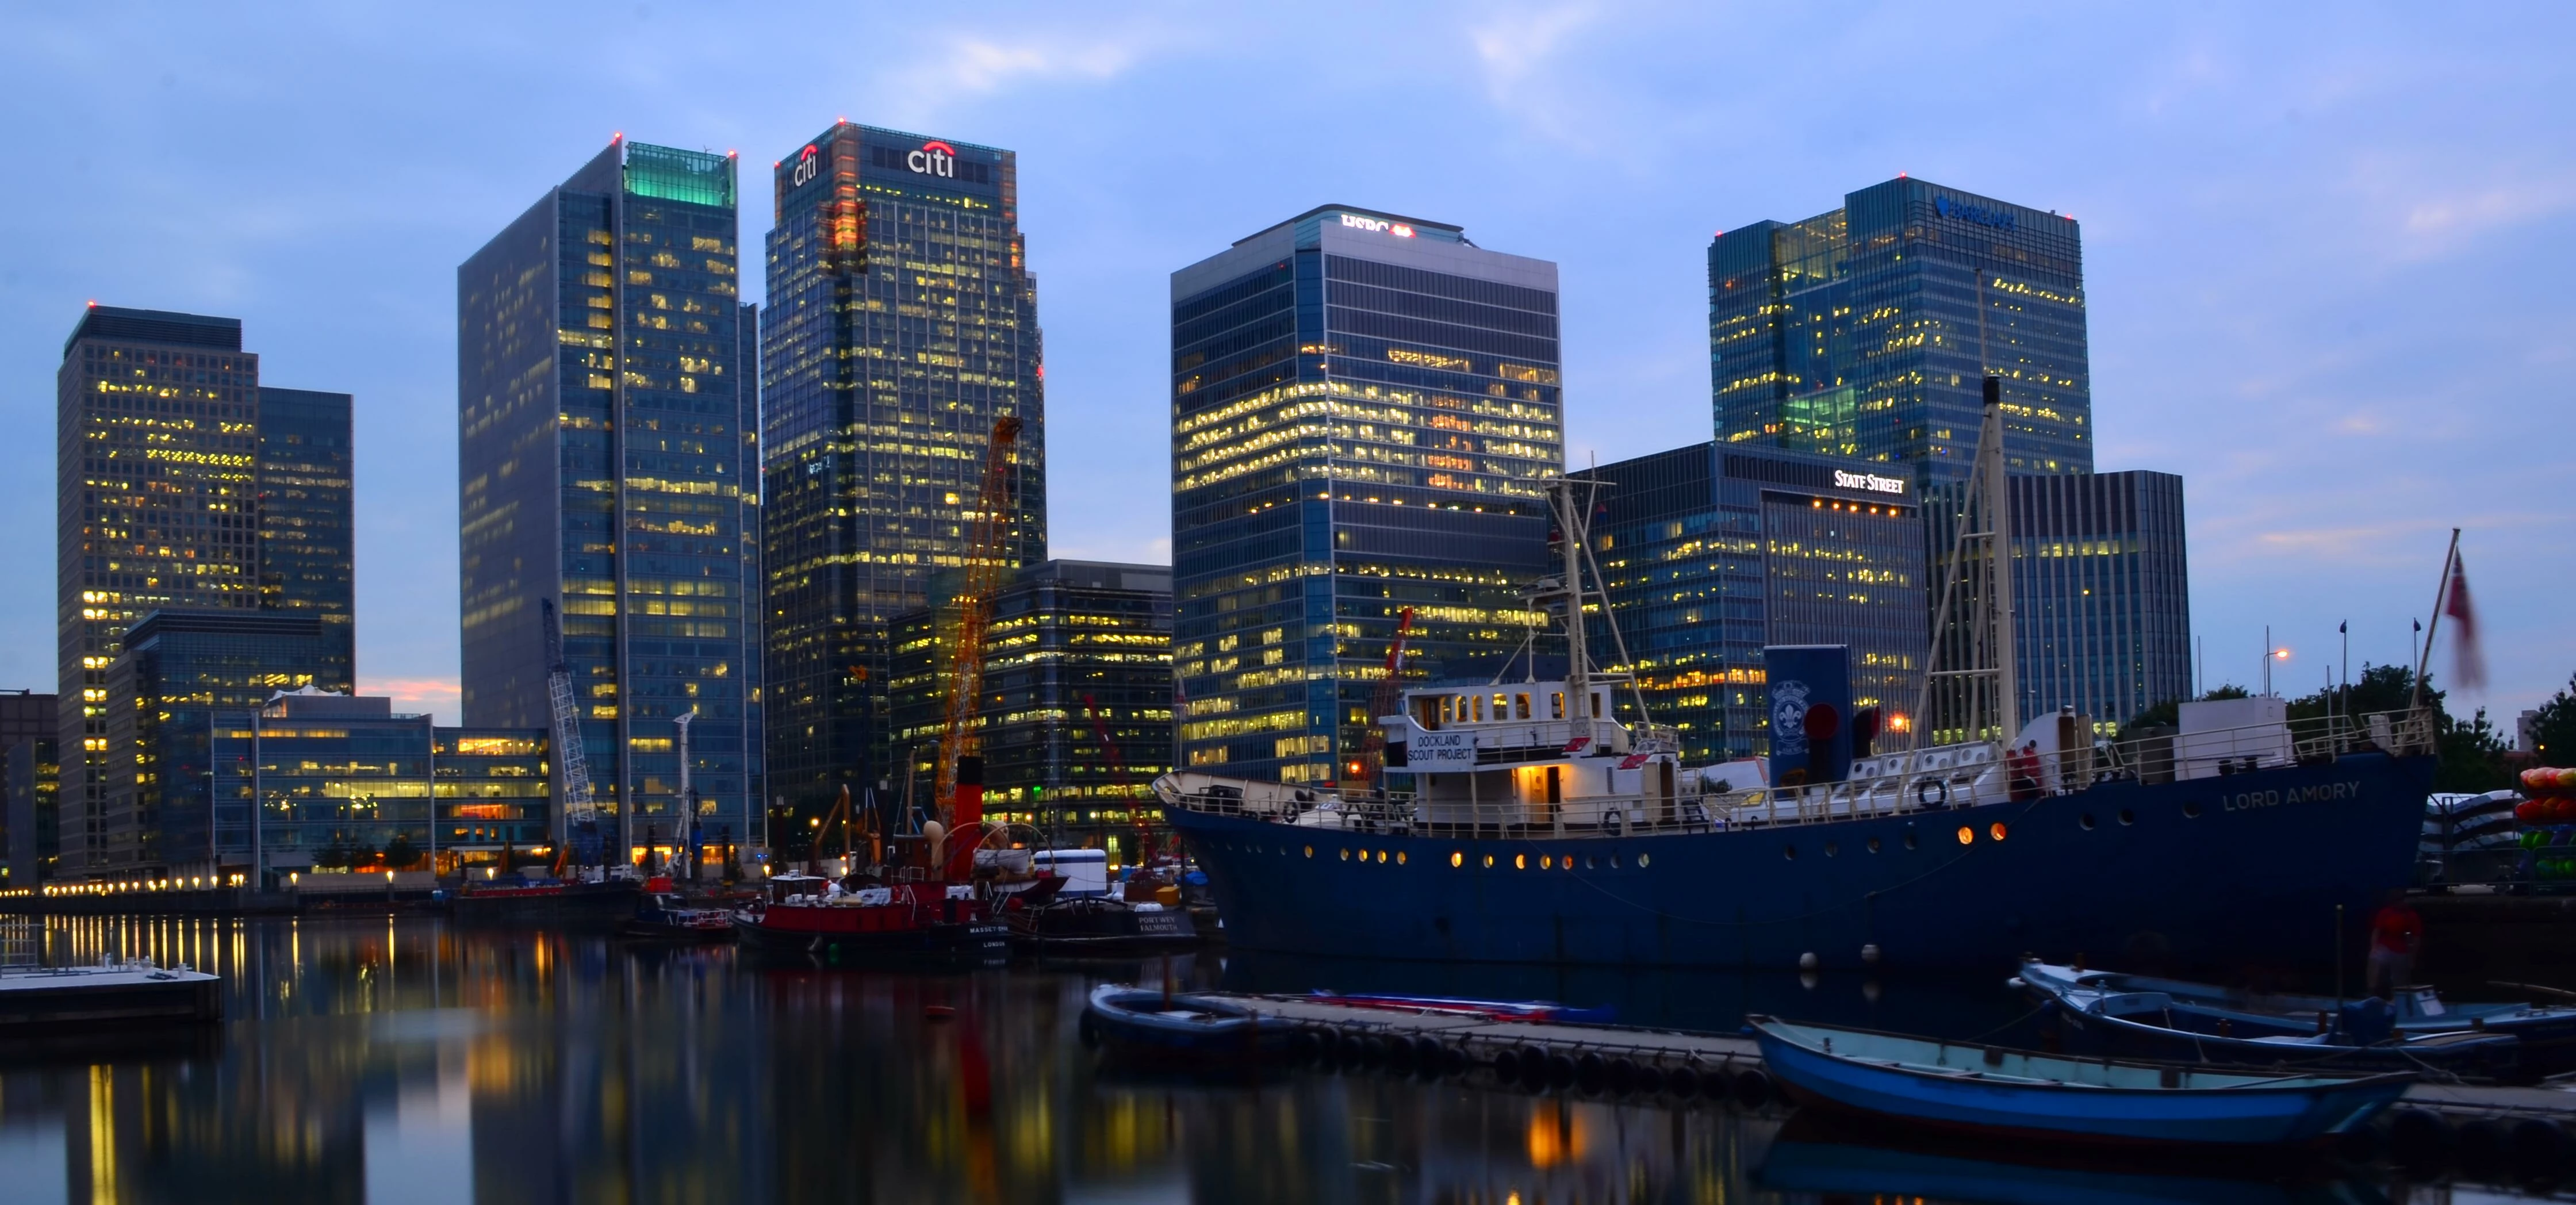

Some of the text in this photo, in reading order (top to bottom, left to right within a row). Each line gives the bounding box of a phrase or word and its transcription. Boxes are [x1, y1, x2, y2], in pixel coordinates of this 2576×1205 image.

[795, 144, 816, 187] citi
[907, 141, 954, 178] citi
[1951, 202, 2015, 231] BARCLAYS
[1835, 470, 1904, 493] STATE STREET
[1408, 748, 1472, 761] SCOUT PROJECT
[1418, 735, 1460, 747] DOCKLAND
[2223, 781, 2360, 811] LORD AMORY
